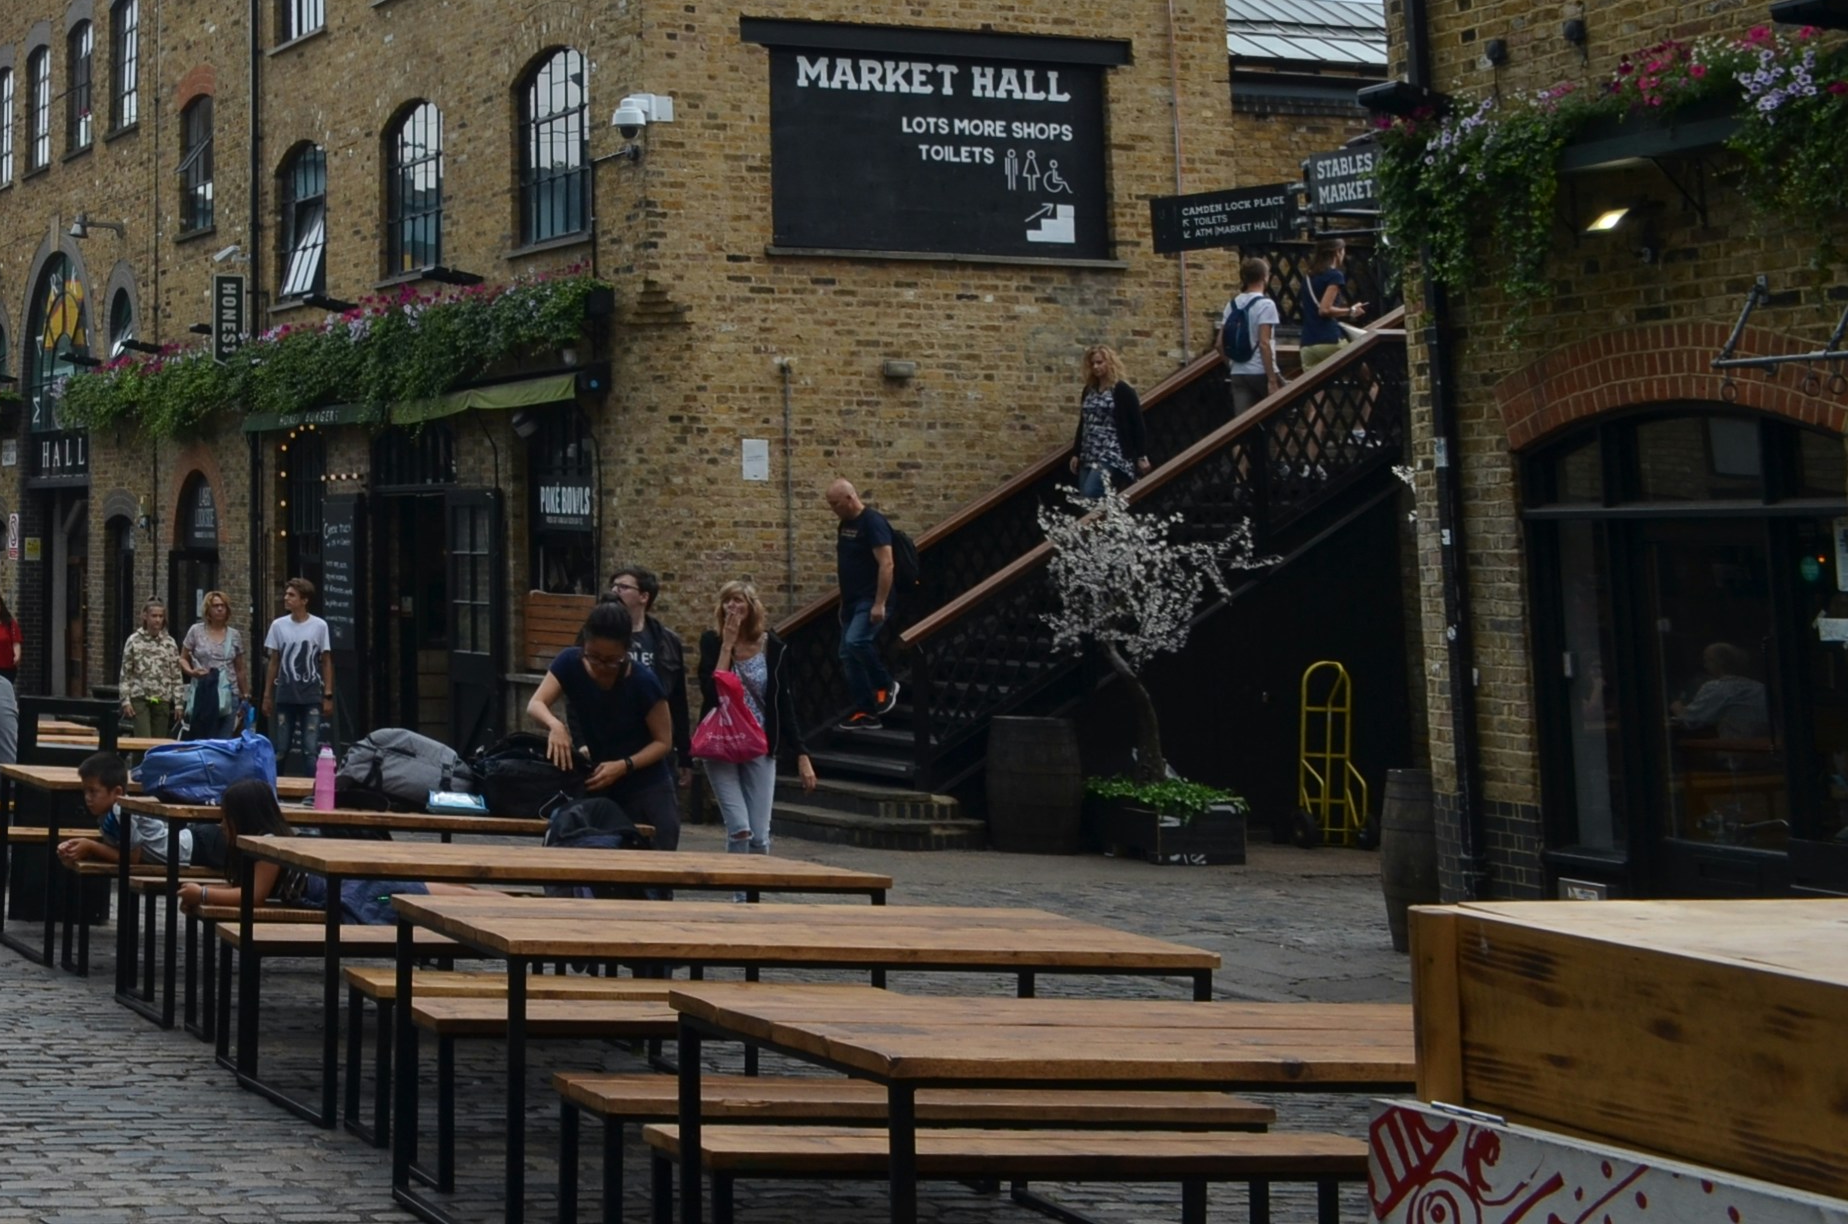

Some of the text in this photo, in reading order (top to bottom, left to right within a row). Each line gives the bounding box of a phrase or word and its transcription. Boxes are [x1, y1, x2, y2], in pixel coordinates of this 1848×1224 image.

[796, 56, 1071, 102] MARKET HALL
[902, 117, 1073, 142] LOTS MORE SHOPS
[918, 144, 994, 164] TOILETS
[1316, 153, 1373, 179] STABLES
[1318, 179, 1373, 205] MARKET
[1181, 195, 1285, 217] CAMDEN LOCK PLACE
[1194, 215, 1229, 226] TOILETS
[1195, 227, 1214, 237] ATM
[41, 438, 85, 468] HALL
[540, 482, 590, 515] POKÉ BOWLS
